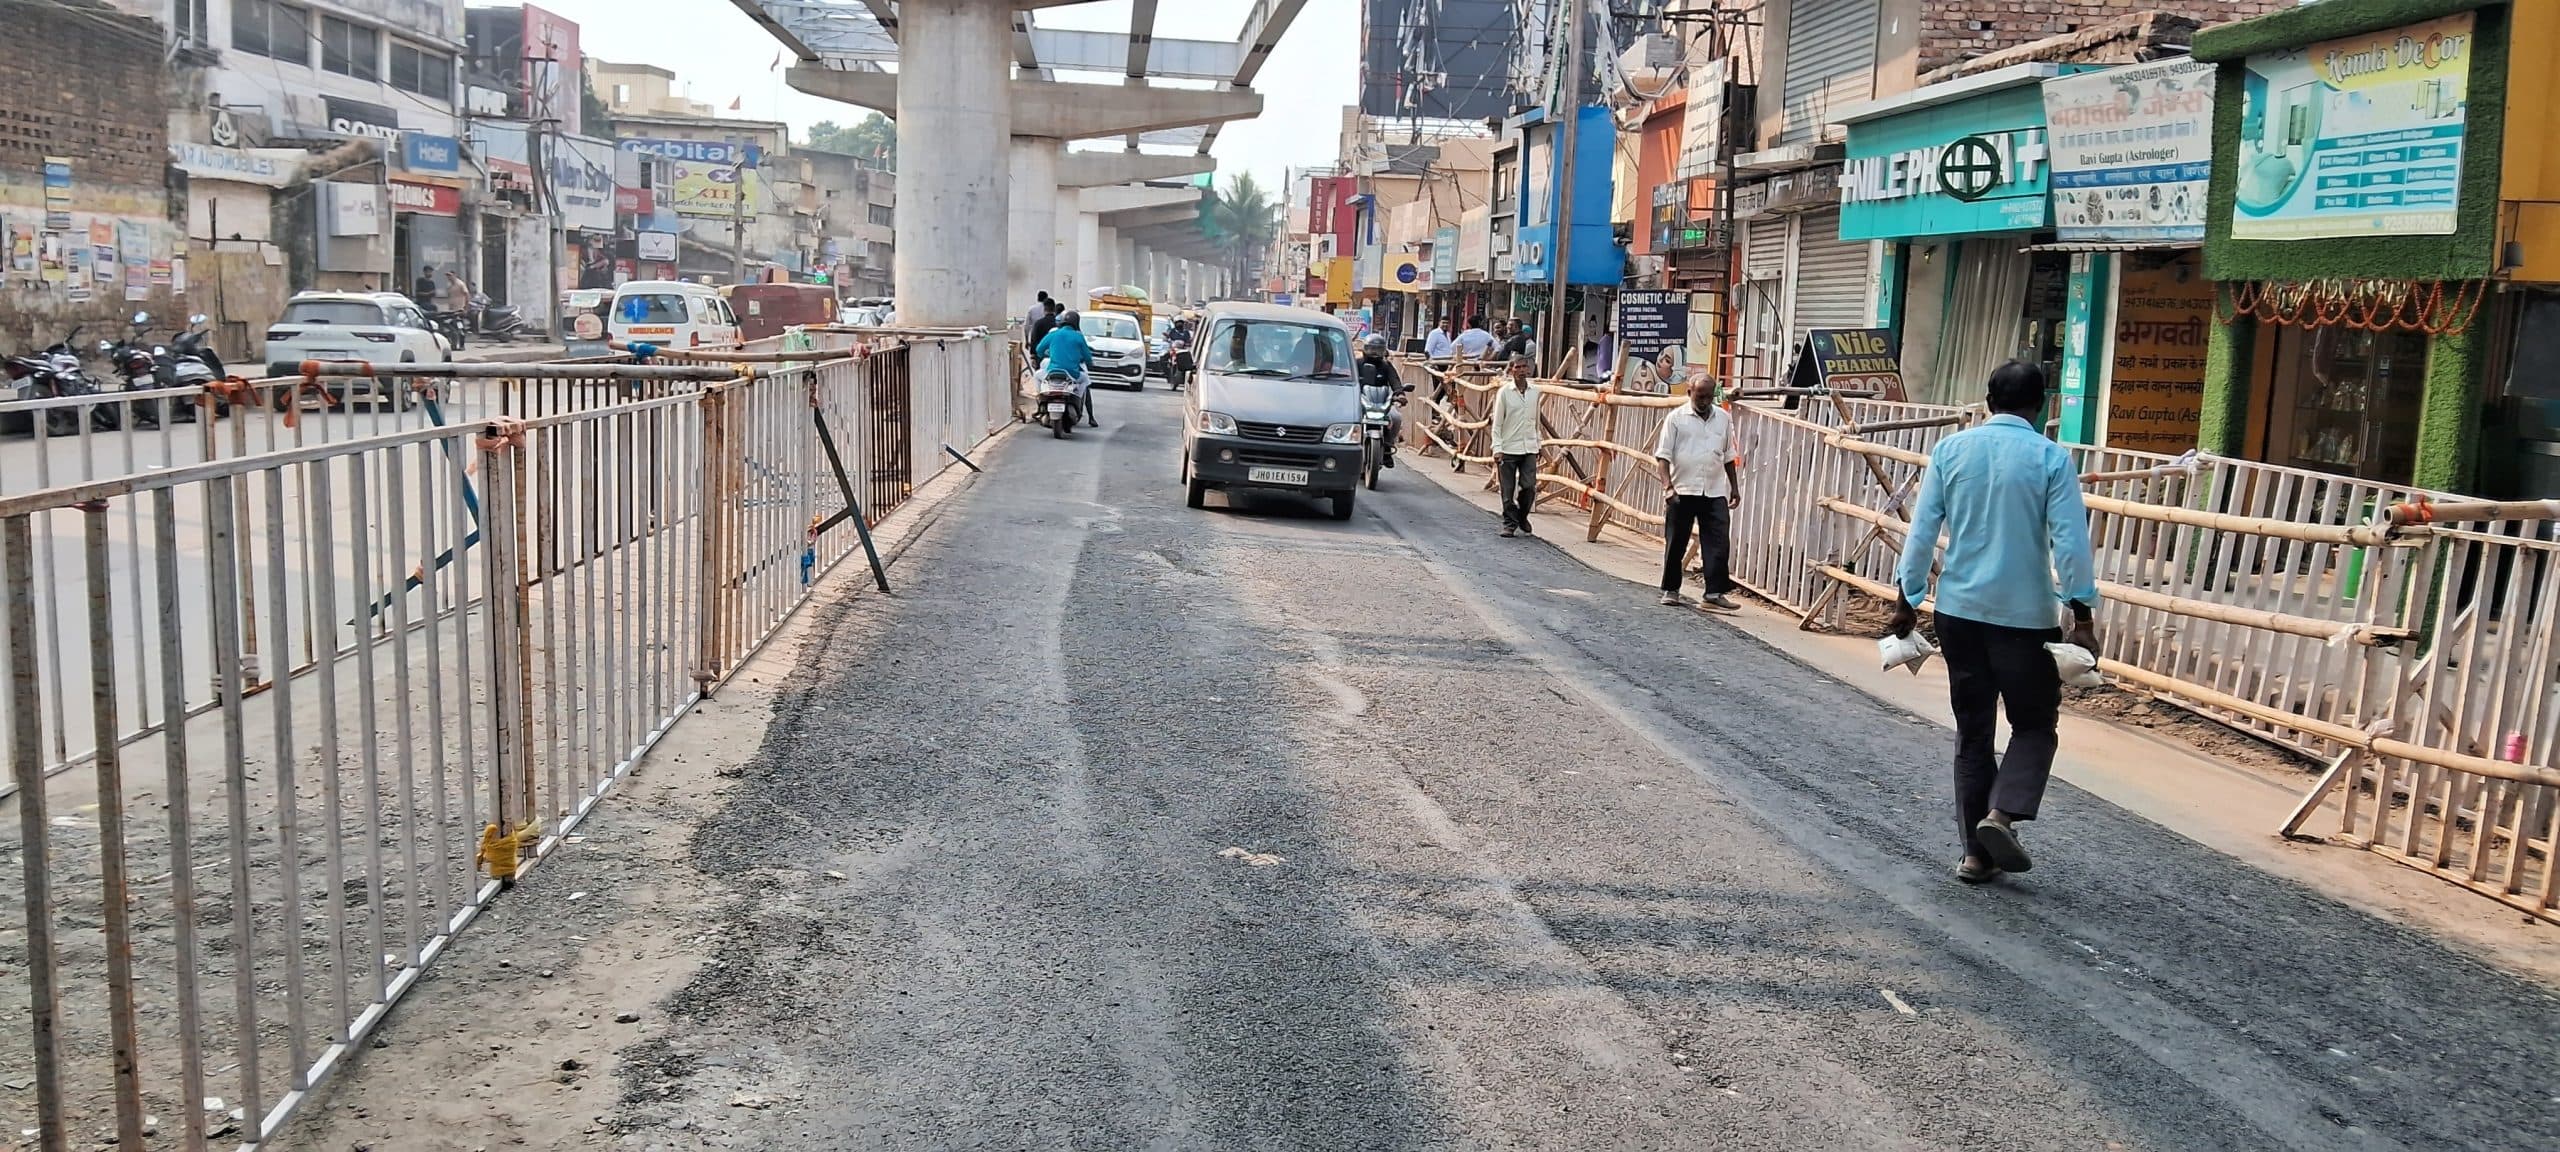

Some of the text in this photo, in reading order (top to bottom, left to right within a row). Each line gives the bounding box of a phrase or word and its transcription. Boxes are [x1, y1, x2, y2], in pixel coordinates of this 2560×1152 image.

[2325, 42, 2388, 82] Kamla
[418, 141, 449, 163] Haier
[2100, 151, 2123, 165] Gupta
[2126, 147, 2179, 163] (Astrologer)
[1621, 292, 1687, 305] COSMETIC CARE
[628, 327, 675, 335] AMBULANCE
[1832, 331, 1887, 355] Nile
[1824, 358, 1899, 373] PHARMA
[2110, 404, 2136, 419] Ravi
[2138, 405, 2175, 425] Gupta
[1256, 470, 1306, 483] JH01EK1594
